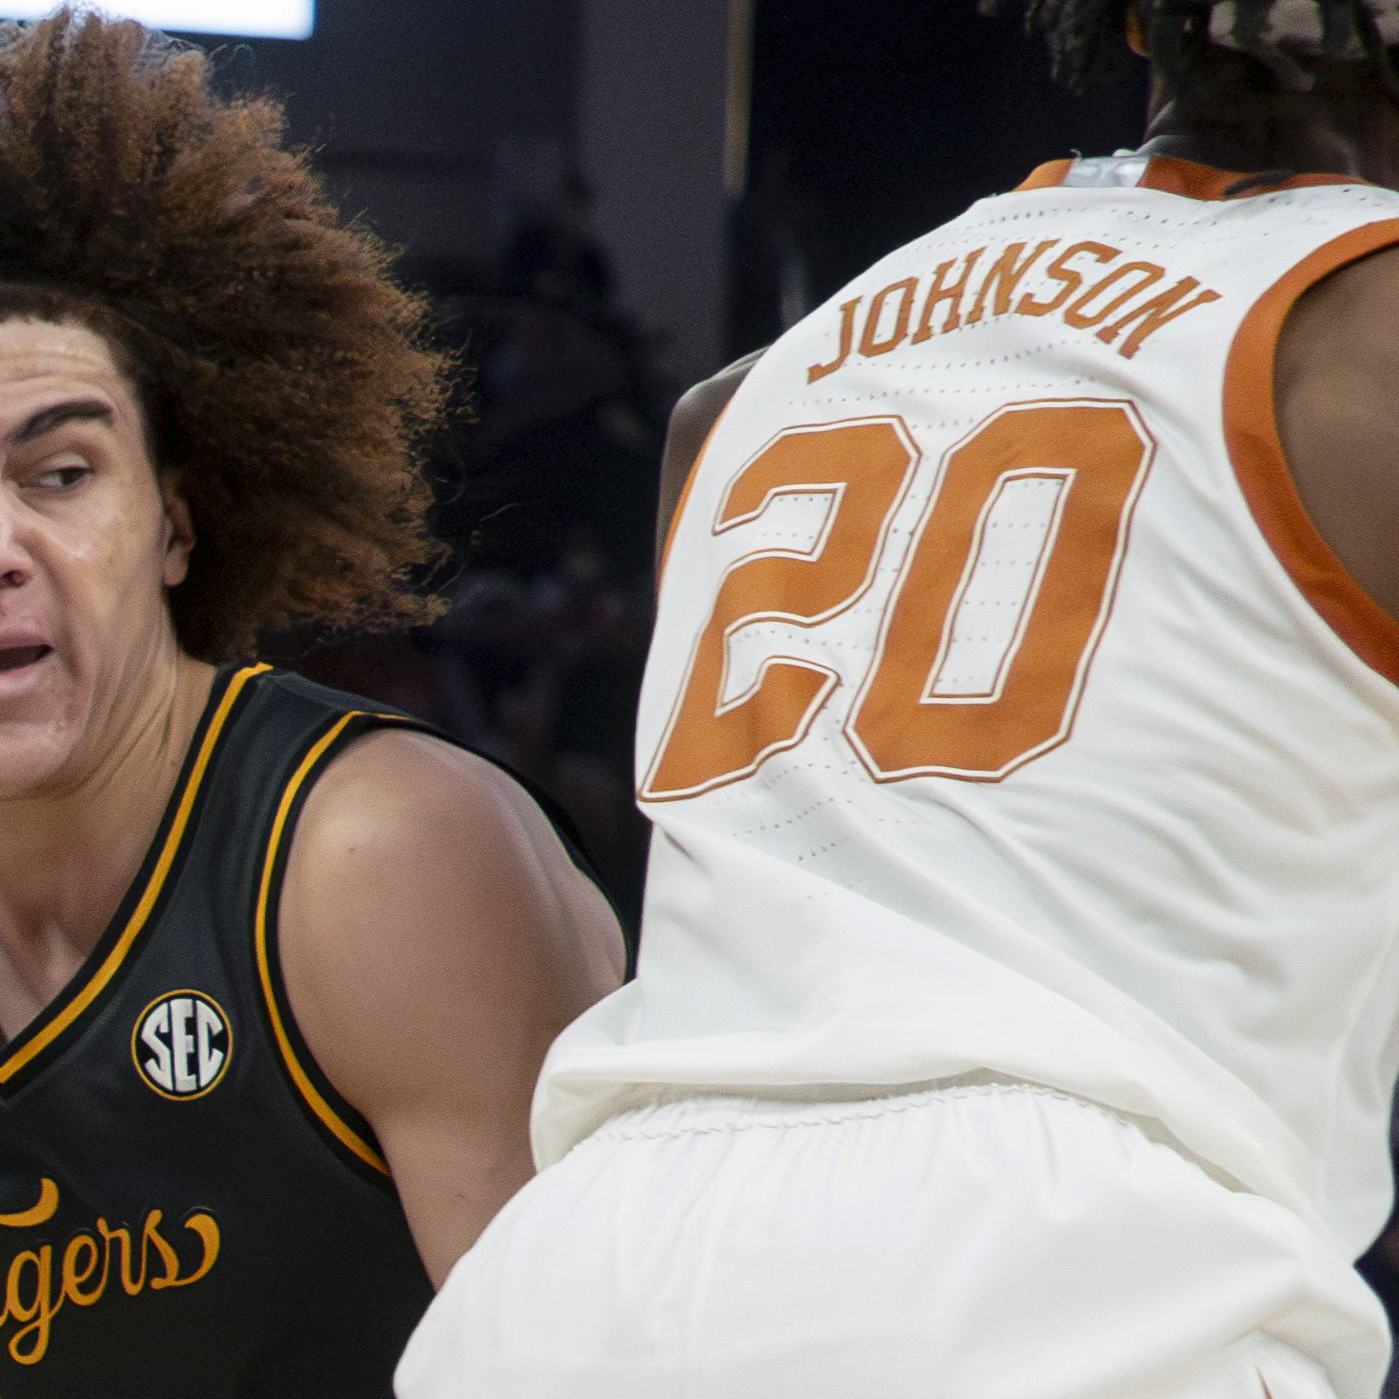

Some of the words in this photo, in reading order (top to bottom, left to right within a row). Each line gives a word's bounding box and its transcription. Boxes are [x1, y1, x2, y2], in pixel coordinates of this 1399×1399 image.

[807, 237, 1223, 385] JOHNSON
[637, 397, 1157, 803] 20
[140, 997, 224, 1093] SEC
